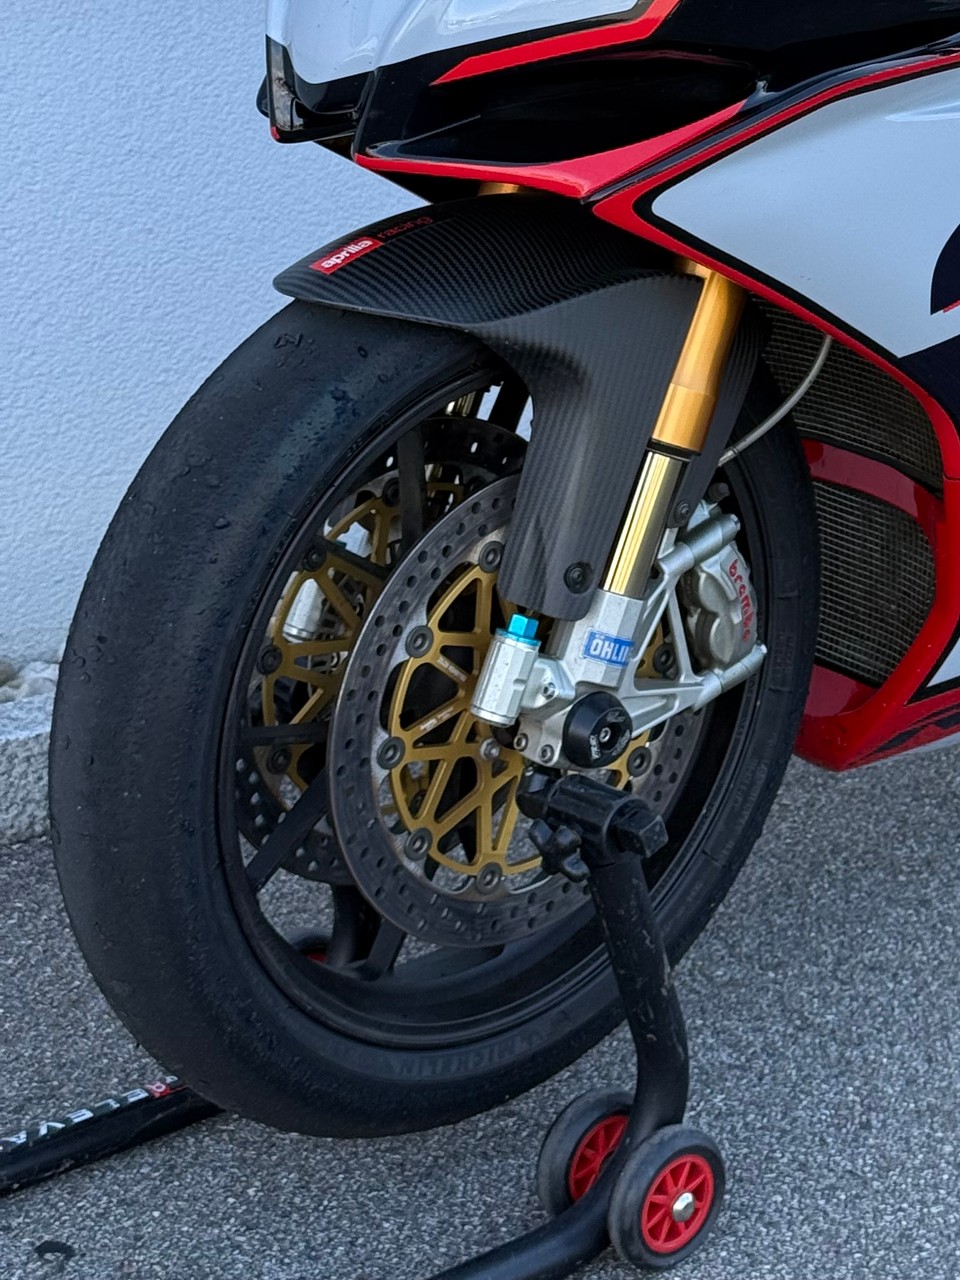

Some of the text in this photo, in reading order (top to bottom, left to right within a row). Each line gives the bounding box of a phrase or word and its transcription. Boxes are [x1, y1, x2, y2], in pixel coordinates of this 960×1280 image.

[320, 216, 434, 269] aprilia racing
[728, 558, 753, 645] brembo
